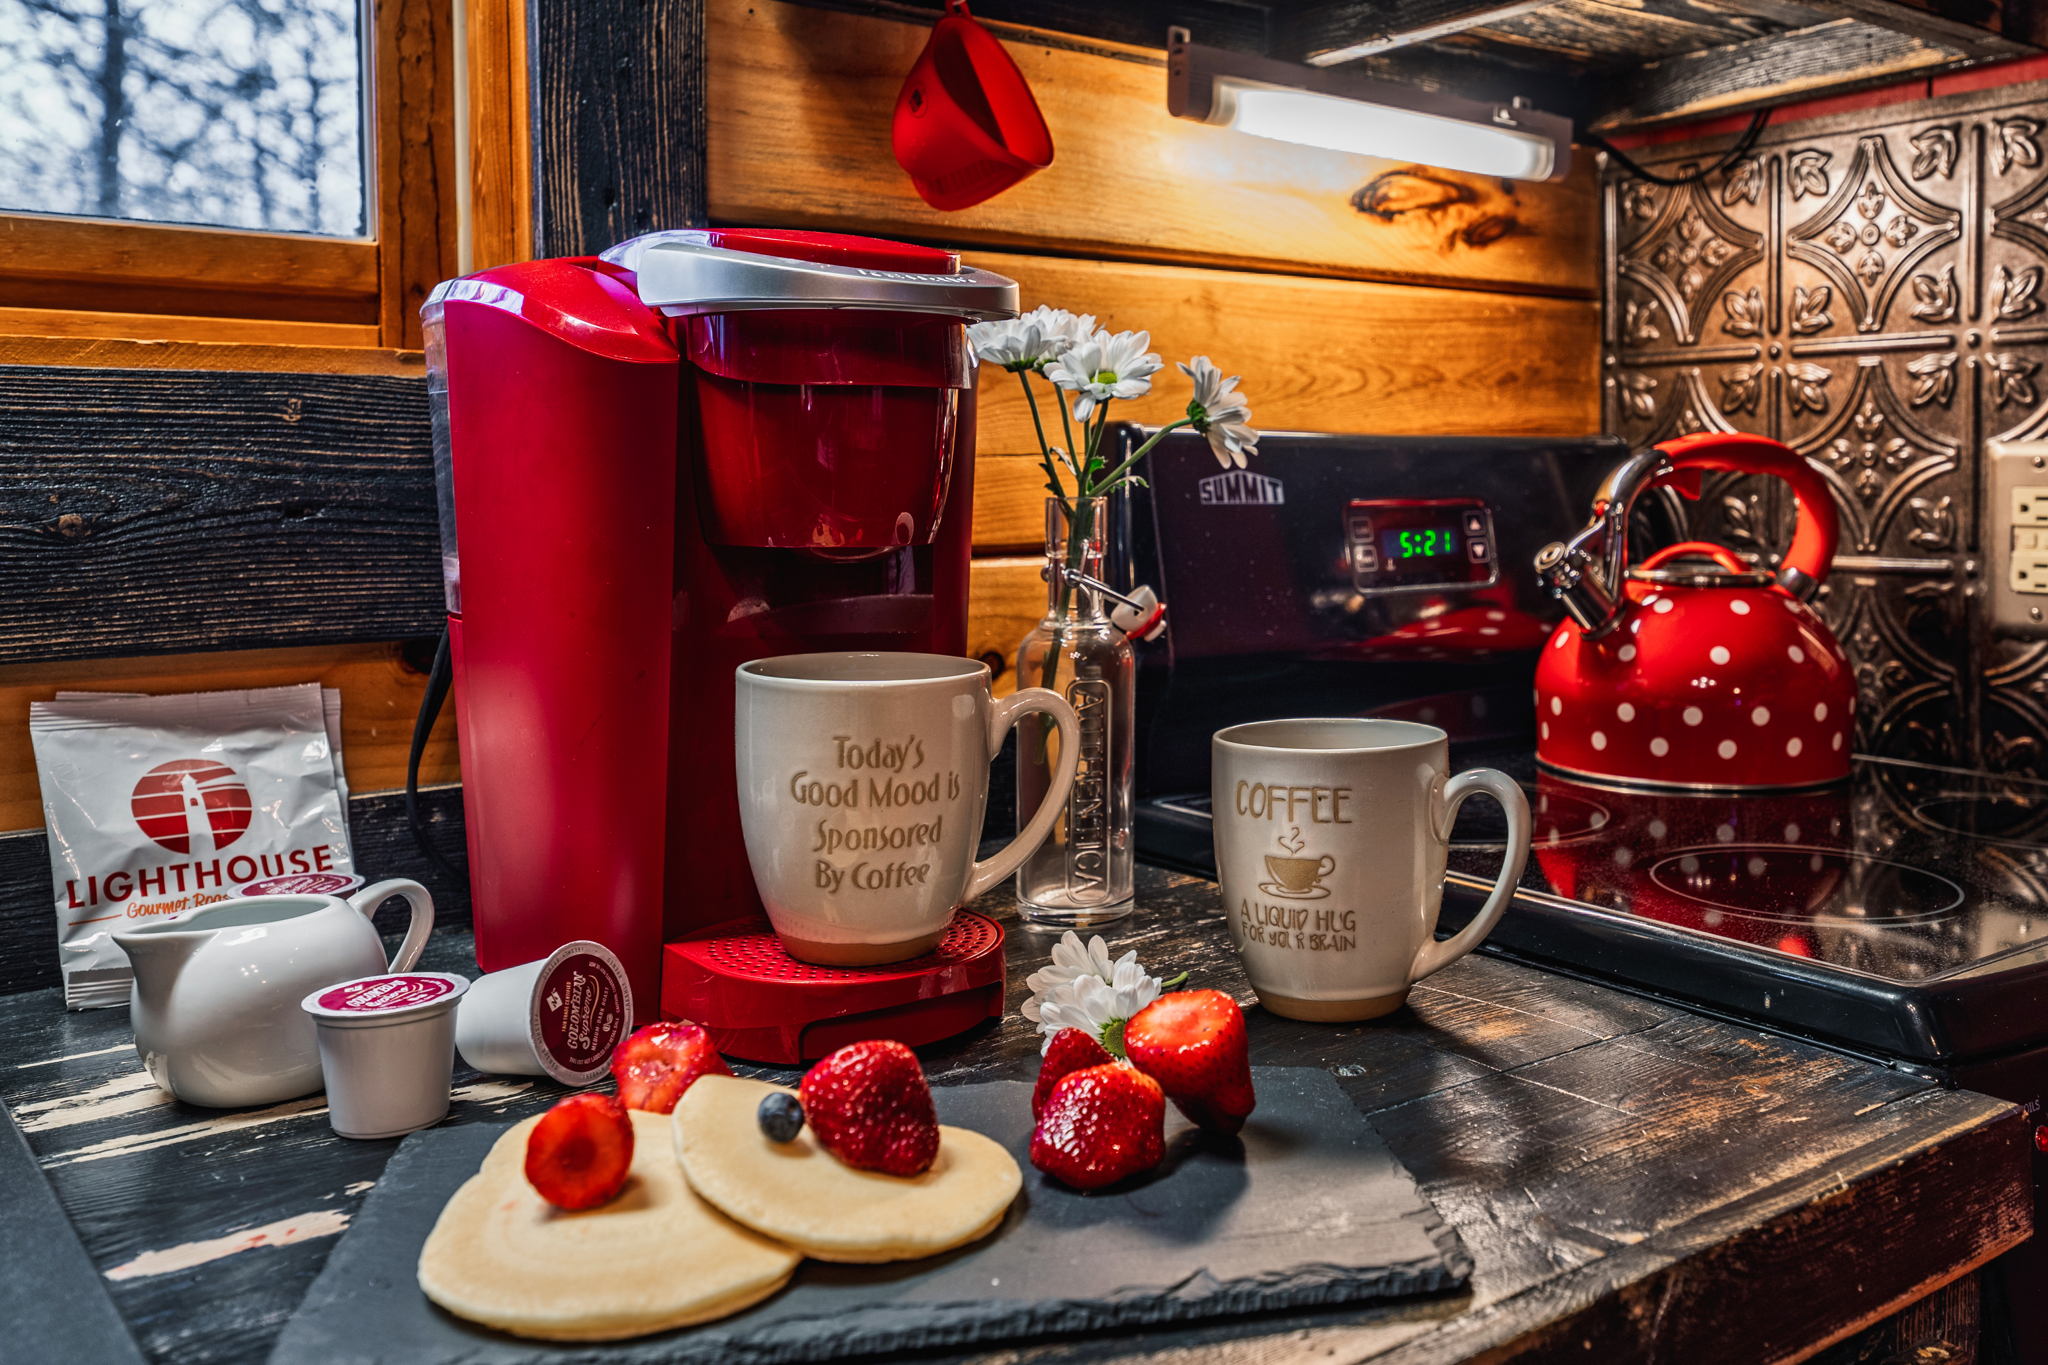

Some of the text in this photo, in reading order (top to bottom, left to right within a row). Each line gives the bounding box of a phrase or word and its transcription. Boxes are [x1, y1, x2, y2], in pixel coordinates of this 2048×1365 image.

[1201, 472, 1281, 502] SUMMIT
[1399, 529, 1451, 558] 5:21
[832, 734, 925, 773] Today's
[790, 771, 961, 808] Good Mood is
[1235, 779, 1353, 824] COFFEE
[813, 814, 943, 855] Sponsored
[65, 844, 334, 909] LIGHTHOUSE
[815, 859, 930, 893] By Coffee
[127, 897, 190, 919] Gourmet
[1240, 898, 1357, 933] A LIQUID HUG
[1242, 921, 1357, 951] FOR YOUR BRAIN
[567, 970, 587, 1049] COLOMBIAN
